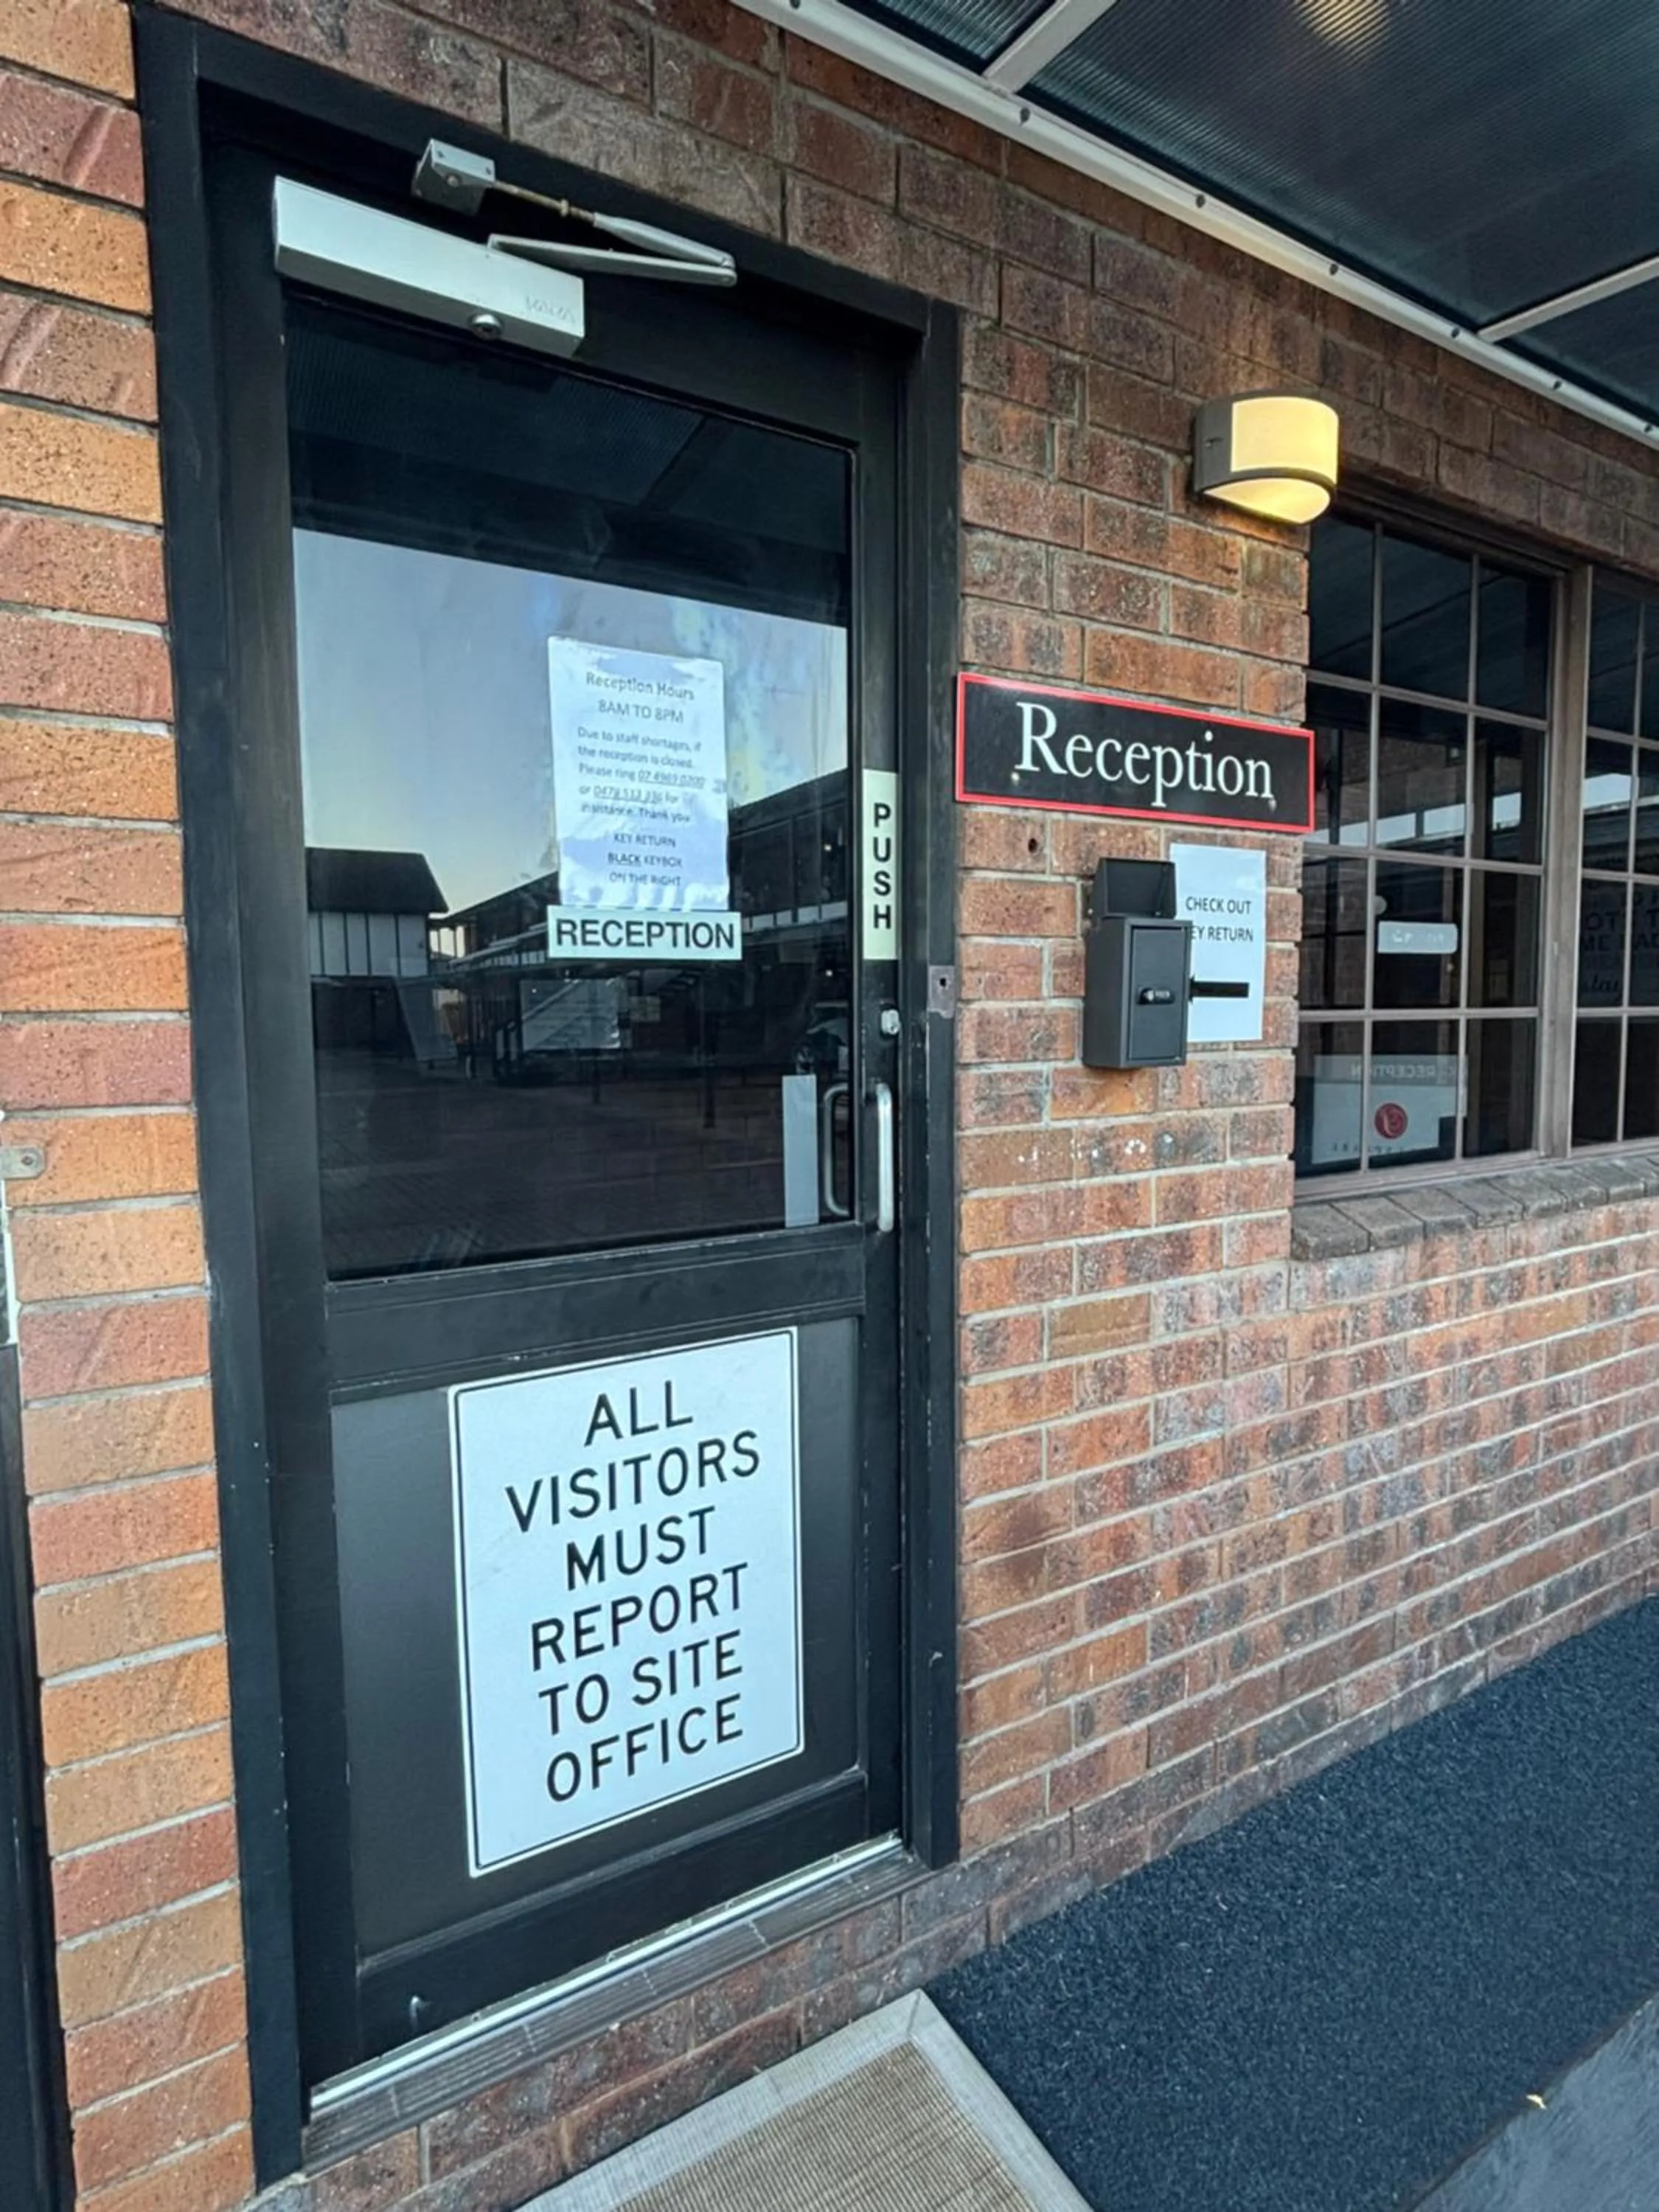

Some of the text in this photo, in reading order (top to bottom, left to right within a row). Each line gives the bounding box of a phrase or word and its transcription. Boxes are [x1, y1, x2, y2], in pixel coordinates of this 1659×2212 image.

[586, 672, 695, 700] Reception Hours
[599, 699, 684, 723] 8AM TO 8PM
[577, 726, 599, 740] Due
[602, 731, 613, 741] to
[616, 733, 639, 744] staff
[578, 745, 596, 757] the
[599, 748, 648, 763] reception
[1014, 701, 1273, 808] Reception
[579, 762, 612, 776] Please
[615, 768, 636, 782] ring
[579, 786, 591, 794] or
[639, 807, 668, 819] Thank
[613, 833, 676, 848] KEY RETURN
[608, 852, 682, 867] BLACK KEYBOX
[873, 802, 891, 929] PUSH
[609, 872, 681, 886] ON THE RIGHT
[1185, 896, 1251, 914] CHECK OUT
[556, 919, 734, 949] RECEPTION
[1192, 925, 1253, 942] EY RETURN
[582, 1380, 693, 1447] ALL
[505, 1429, 760, 1534] VISITORS
[566, 1506, 715, 1590] MUST
[531, 1562, 748, 1672] REPORT
[538, 1629, 743, 1736] TO SITE
[546, 1693, 744, 1802] OFFICE
